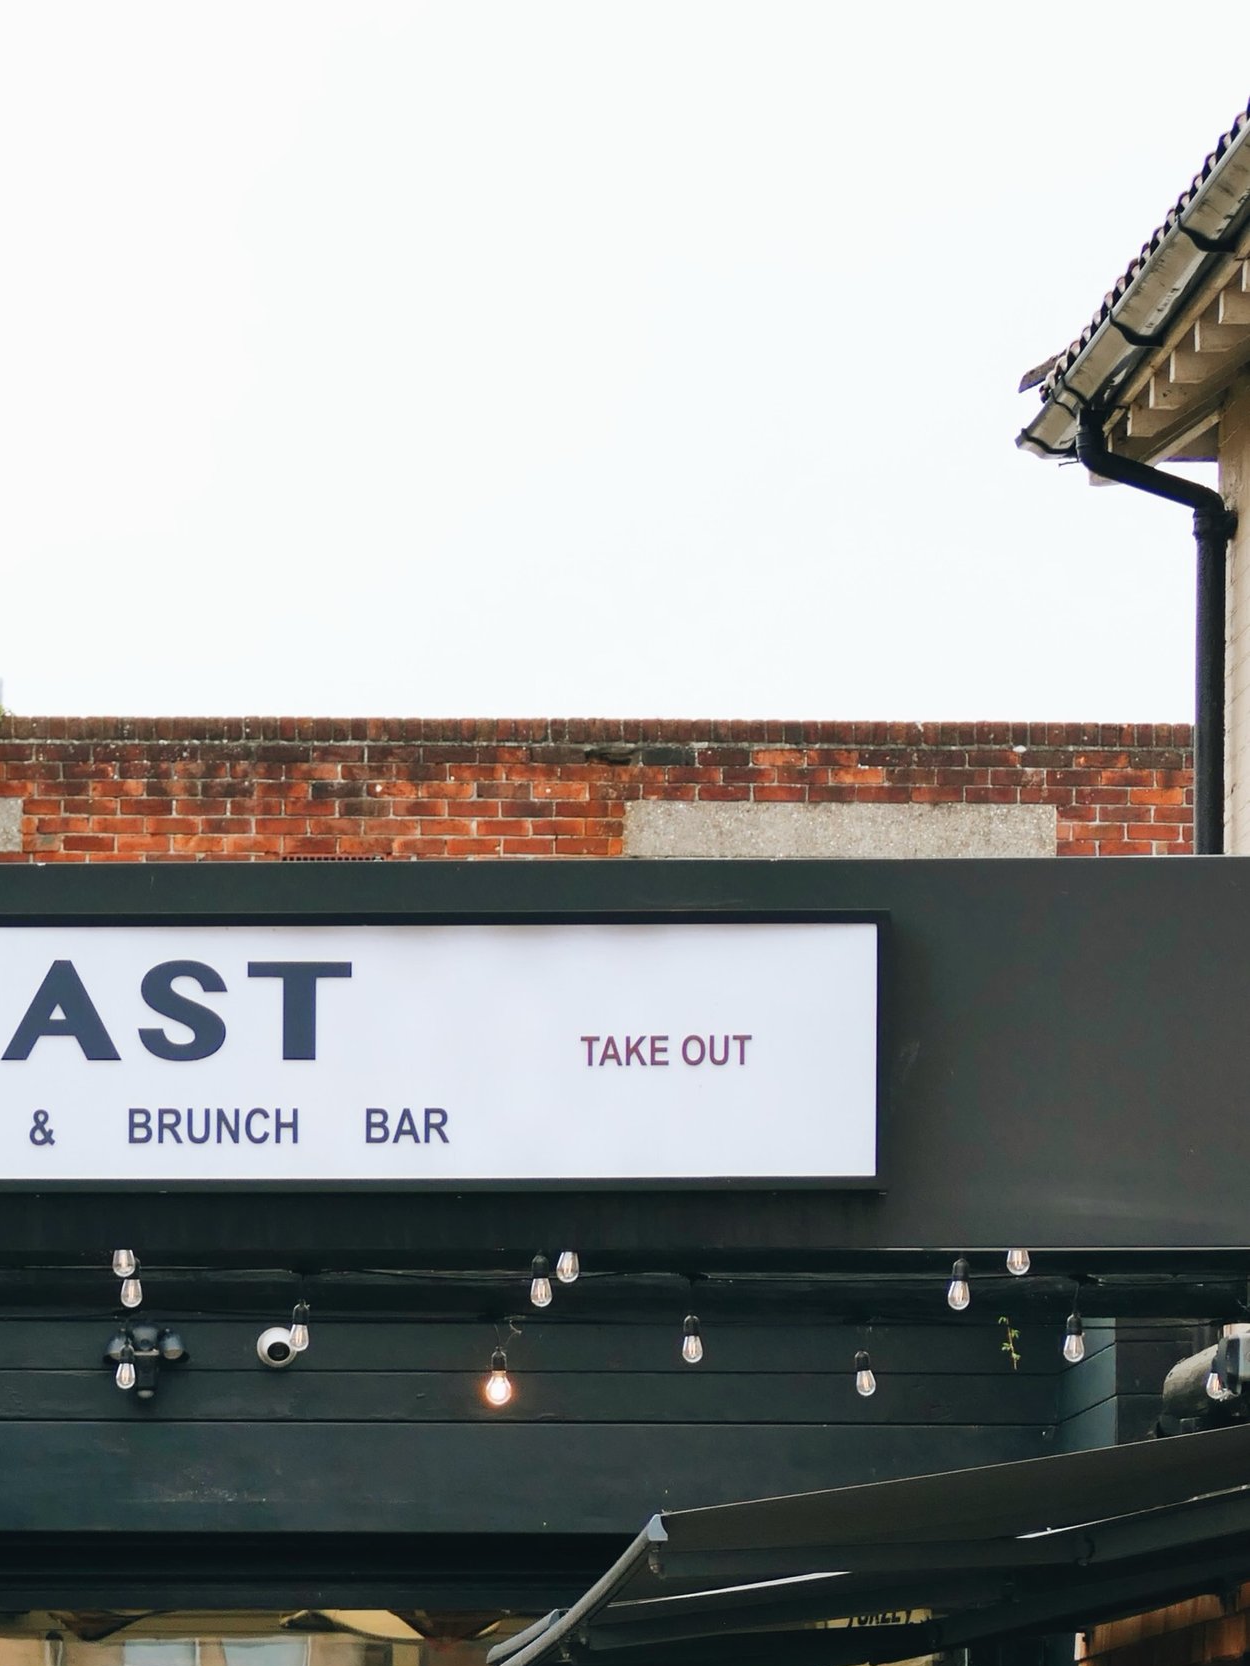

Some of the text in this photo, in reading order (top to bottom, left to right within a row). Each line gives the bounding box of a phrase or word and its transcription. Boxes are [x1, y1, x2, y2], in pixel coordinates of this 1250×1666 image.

[580, 1035, 752, 1067] TAKE OUT
[29, 1109, 56, 1146] &
[128, 1107, 298, 1145] BRUNCH
[365, 1108, 450, 1144] BAR
